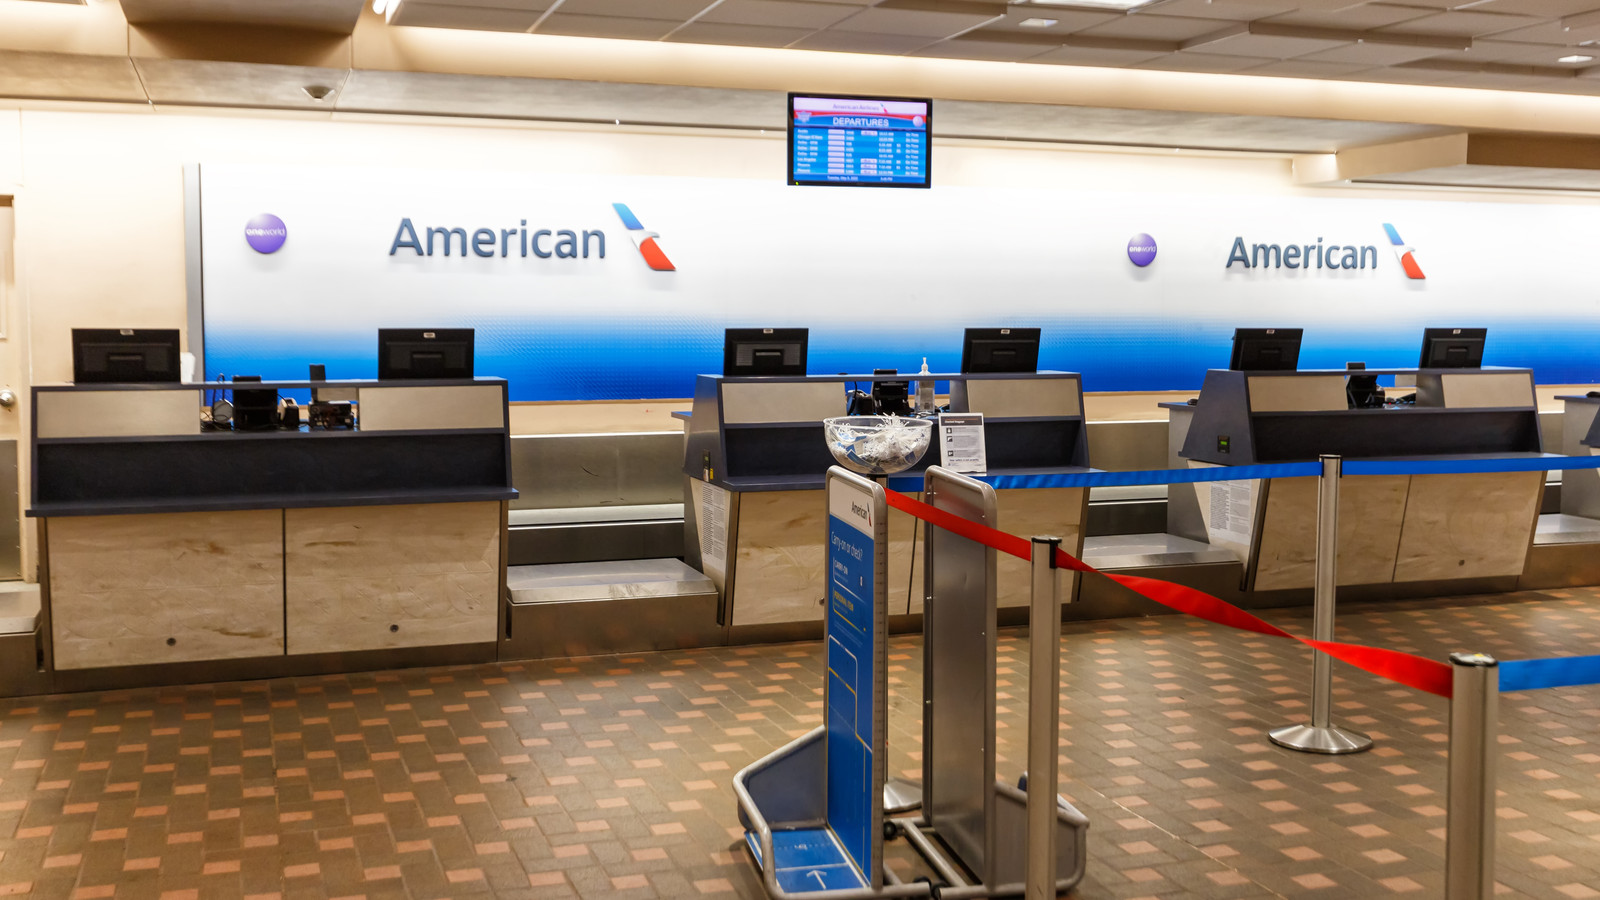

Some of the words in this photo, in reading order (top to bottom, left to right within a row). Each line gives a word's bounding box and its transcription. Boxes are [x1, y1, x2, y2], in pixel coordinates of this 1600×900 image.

[833, 117, 889, 127] DEPARTURES
[246, 227, 286, 237] oneworld
[389, 217, 606, 259] American
[1129, 245, 1156, 253] oneworld
[1225, 236, 1378, 269] American
[851, 501, 868, 520] American
[831, 531, 847, 552] Carry-on
[850, 545, 863, 561] check?
